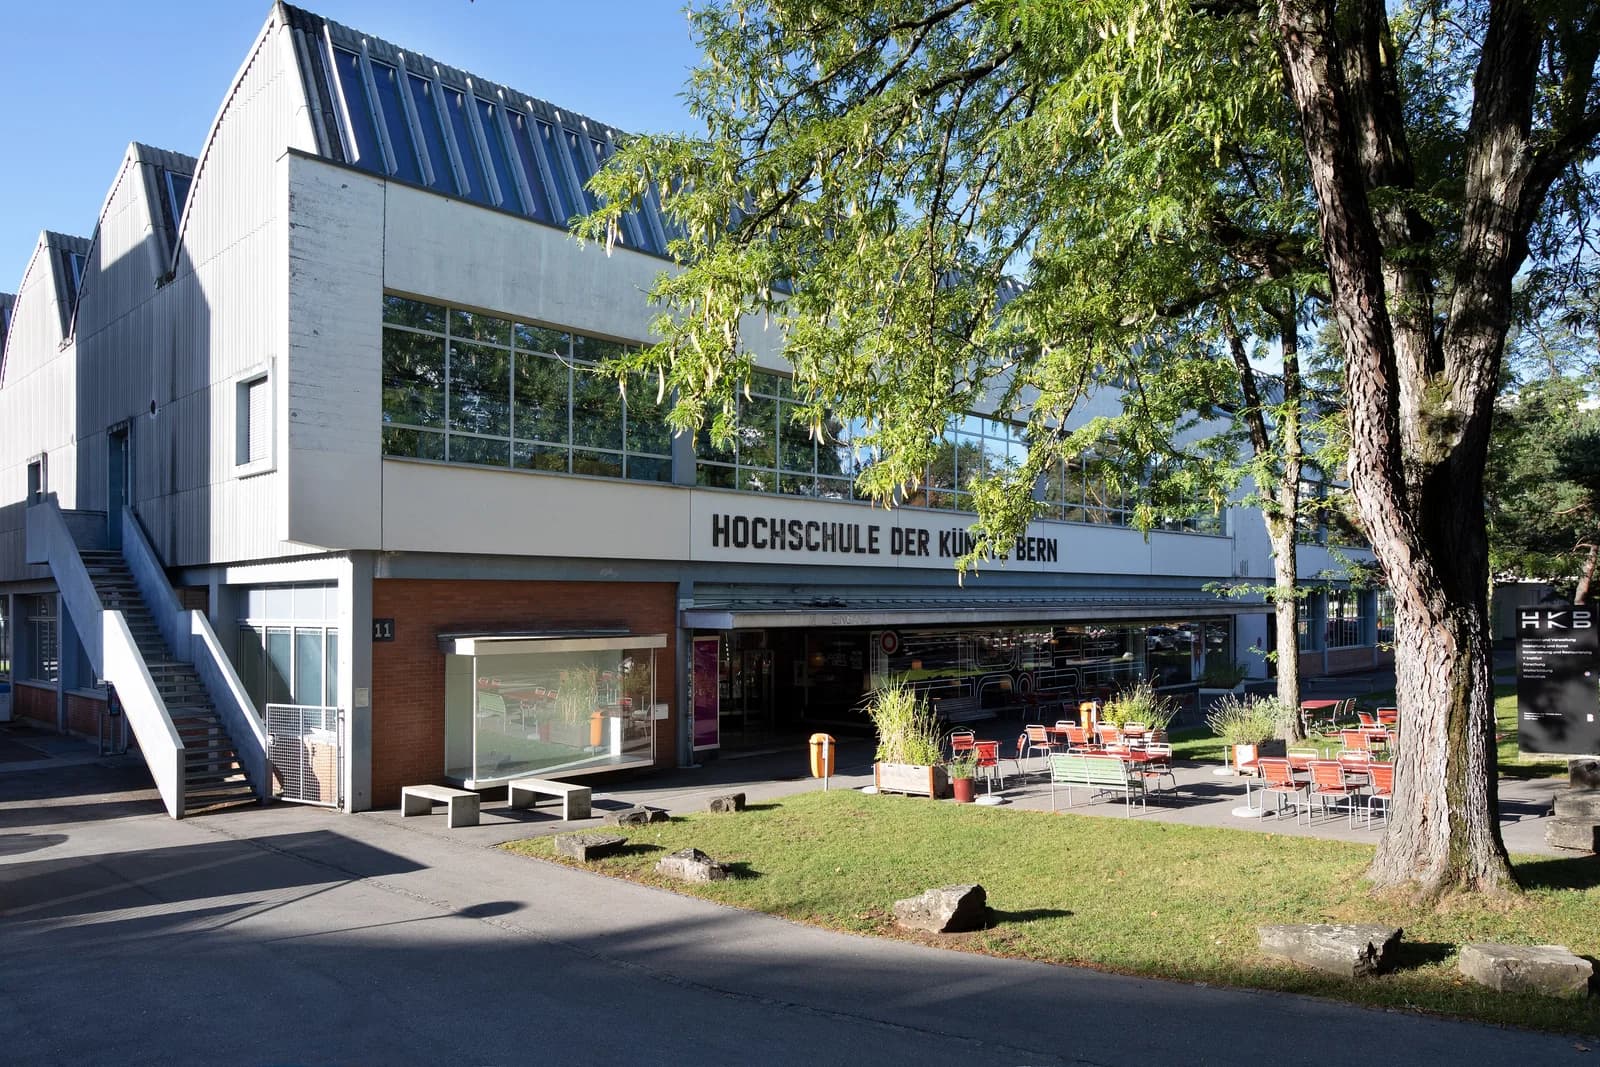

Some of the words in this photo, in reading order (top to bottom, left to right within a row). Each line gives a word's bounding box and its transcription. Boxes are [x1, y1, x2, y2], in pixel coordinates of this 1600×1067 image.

[712, 513, 880, 555] HOCHSCHULE
[891, 527, 930, 557] DER
[1016, 536, 1058, 562] BERN
[1521, 611, 1592, 629] HKB
[375, 623, 391, 638] 11
